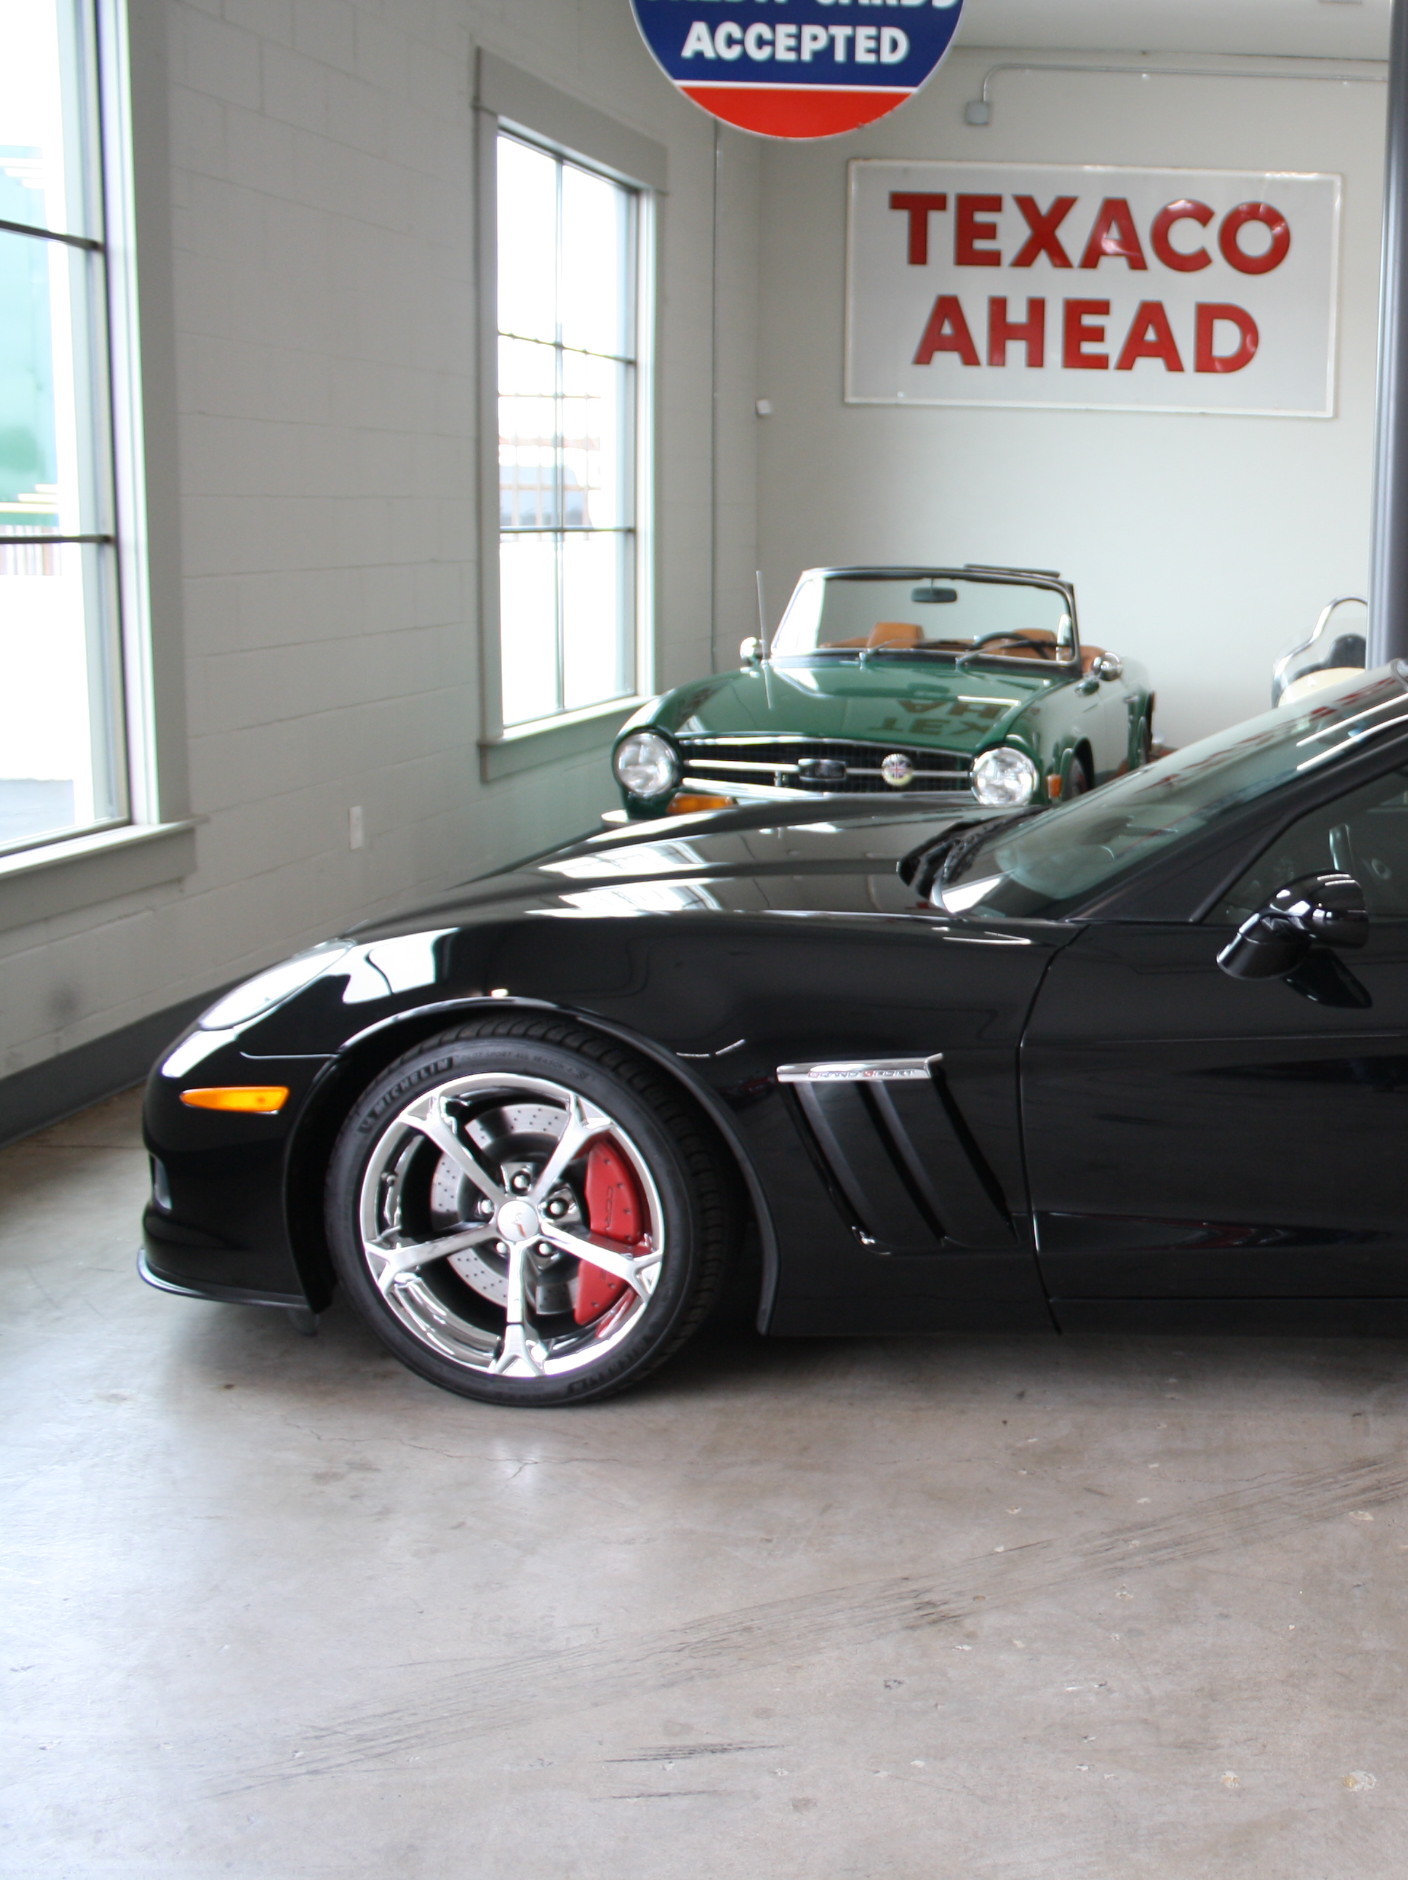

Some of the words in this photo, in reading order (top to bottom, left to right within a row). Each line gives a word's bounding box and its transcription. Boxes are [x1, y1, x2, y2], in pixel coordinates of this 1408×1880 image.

[681, 21, 909, 64] ACCEPTED
[889, 192, 1291, 275] TEXACO
[912, 295, 1259, 374] AHEAD
[373, 1058, 450, 1115] MICHELIN
